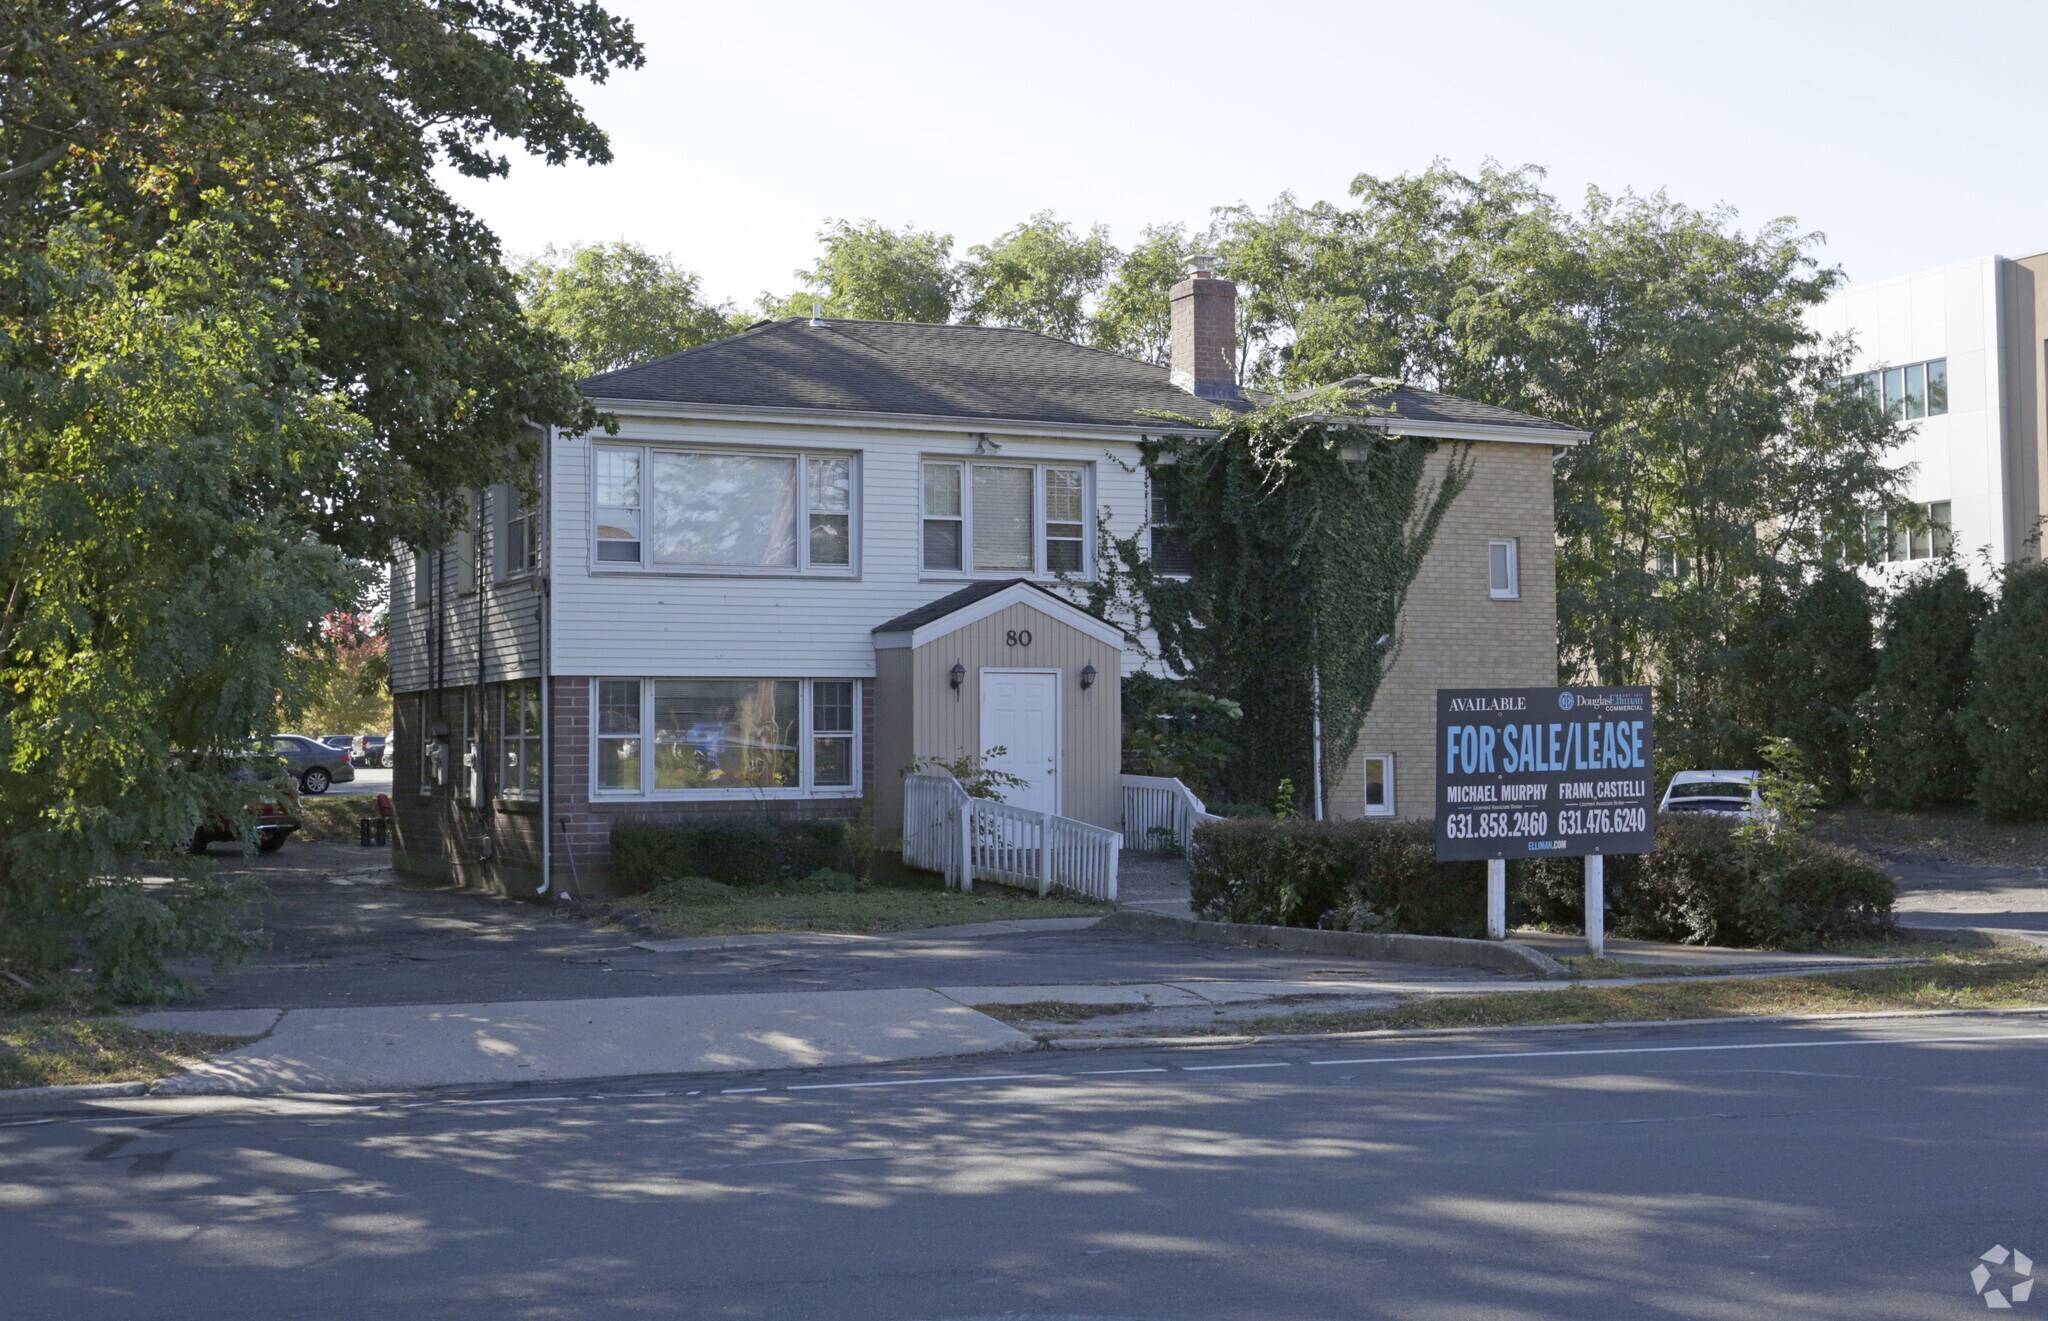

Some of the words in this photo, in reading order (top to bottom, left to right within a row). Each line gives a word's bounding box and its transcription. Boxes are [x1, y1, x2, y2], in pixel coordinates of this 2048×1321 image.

[1006, 629, 1032, 647] 80
[1448, 697, 1527, 712] AVAILABLE
[1447, 725, 1496, 775] FOR
[1502, 720, 1645, 774] SALE/LEASE
[1447, 785, 1498, 803] MICHAEL
[1501, 783, 1548, 801] MURPHY
[1559, 782, 1595, 799] FRANK
[1597, 780, 1645, 799] CASTELLI
[1447, 811, 1548, 839] 631.858.2460
[1558, 807, 1646, 836] 631.476.6240
[1528, 840, 1567, 851] ELLIMAN.COM
